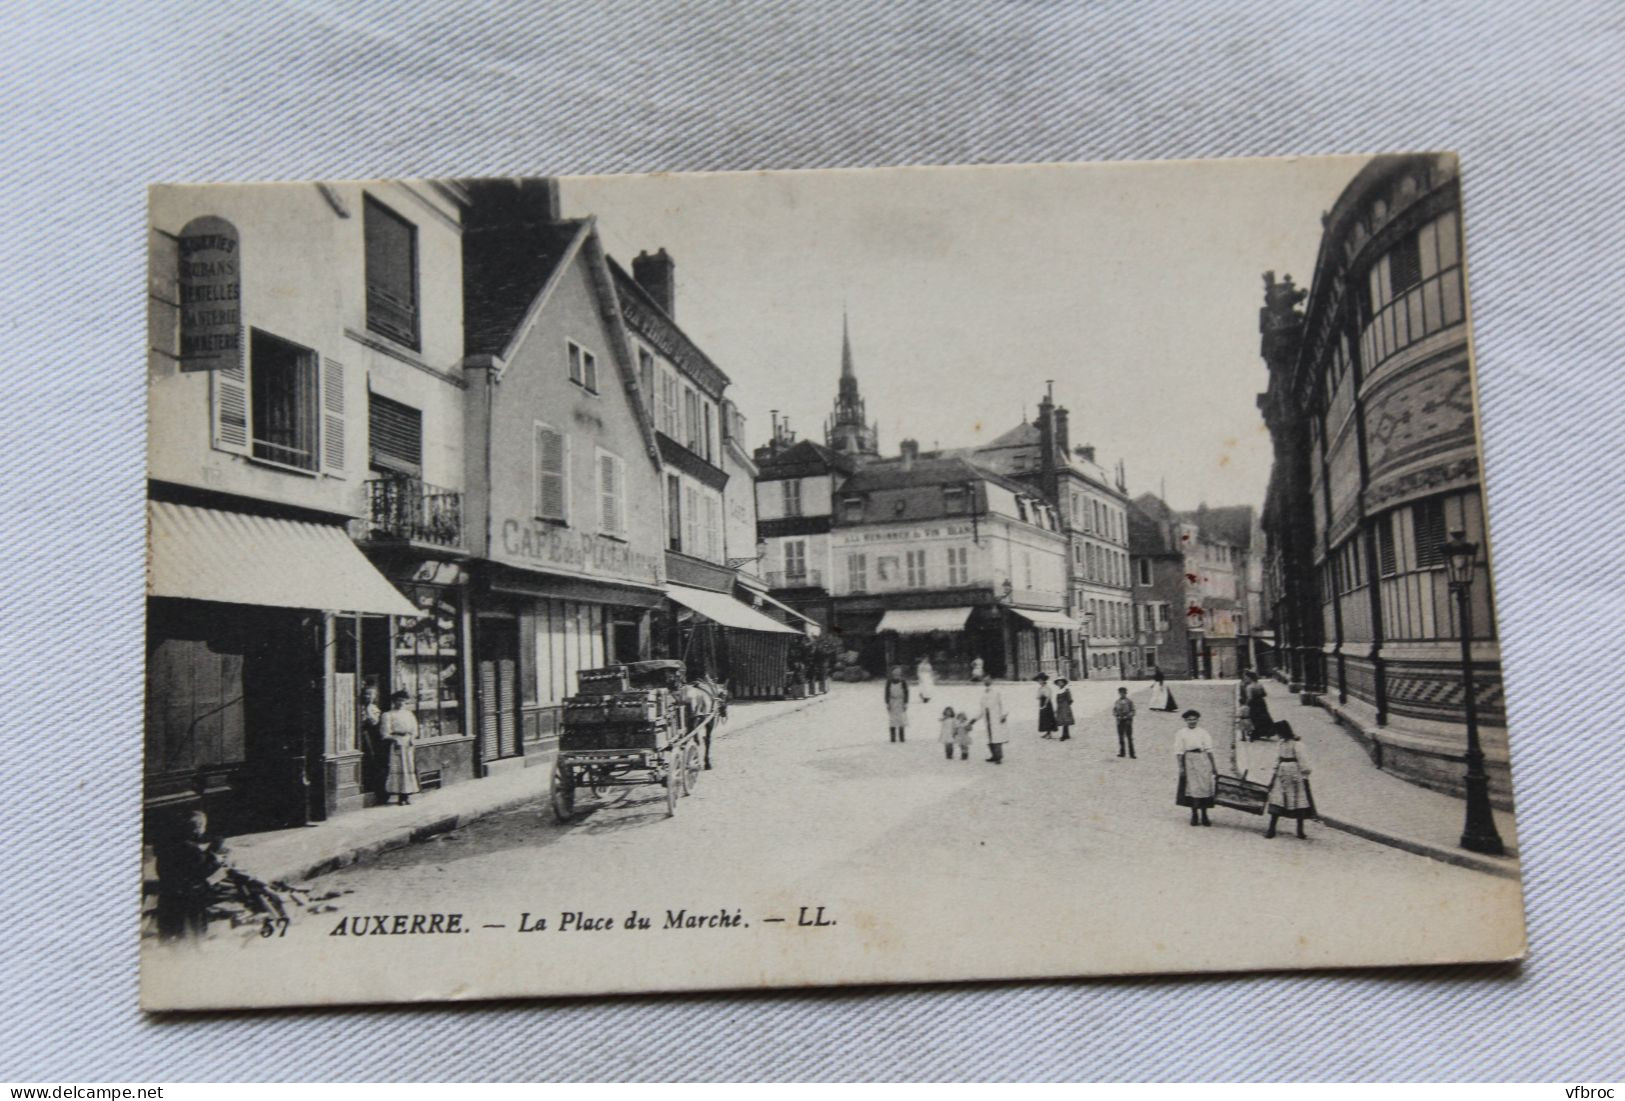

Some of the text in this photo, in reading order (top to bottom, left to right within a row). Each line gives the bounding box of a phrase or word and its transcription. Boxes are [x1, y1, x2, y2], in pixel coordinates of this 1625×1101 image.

[260, 917, 290, 938] 57
[329, 913, 471, 937] AUXERRE.
[518, 912, 547, 933] La
[558, 911, 614, 931] Place
[624, 910, 651, 930] du
[663, 908, 749, 930] Marché.
[797, 906, 837, 927] LL.
